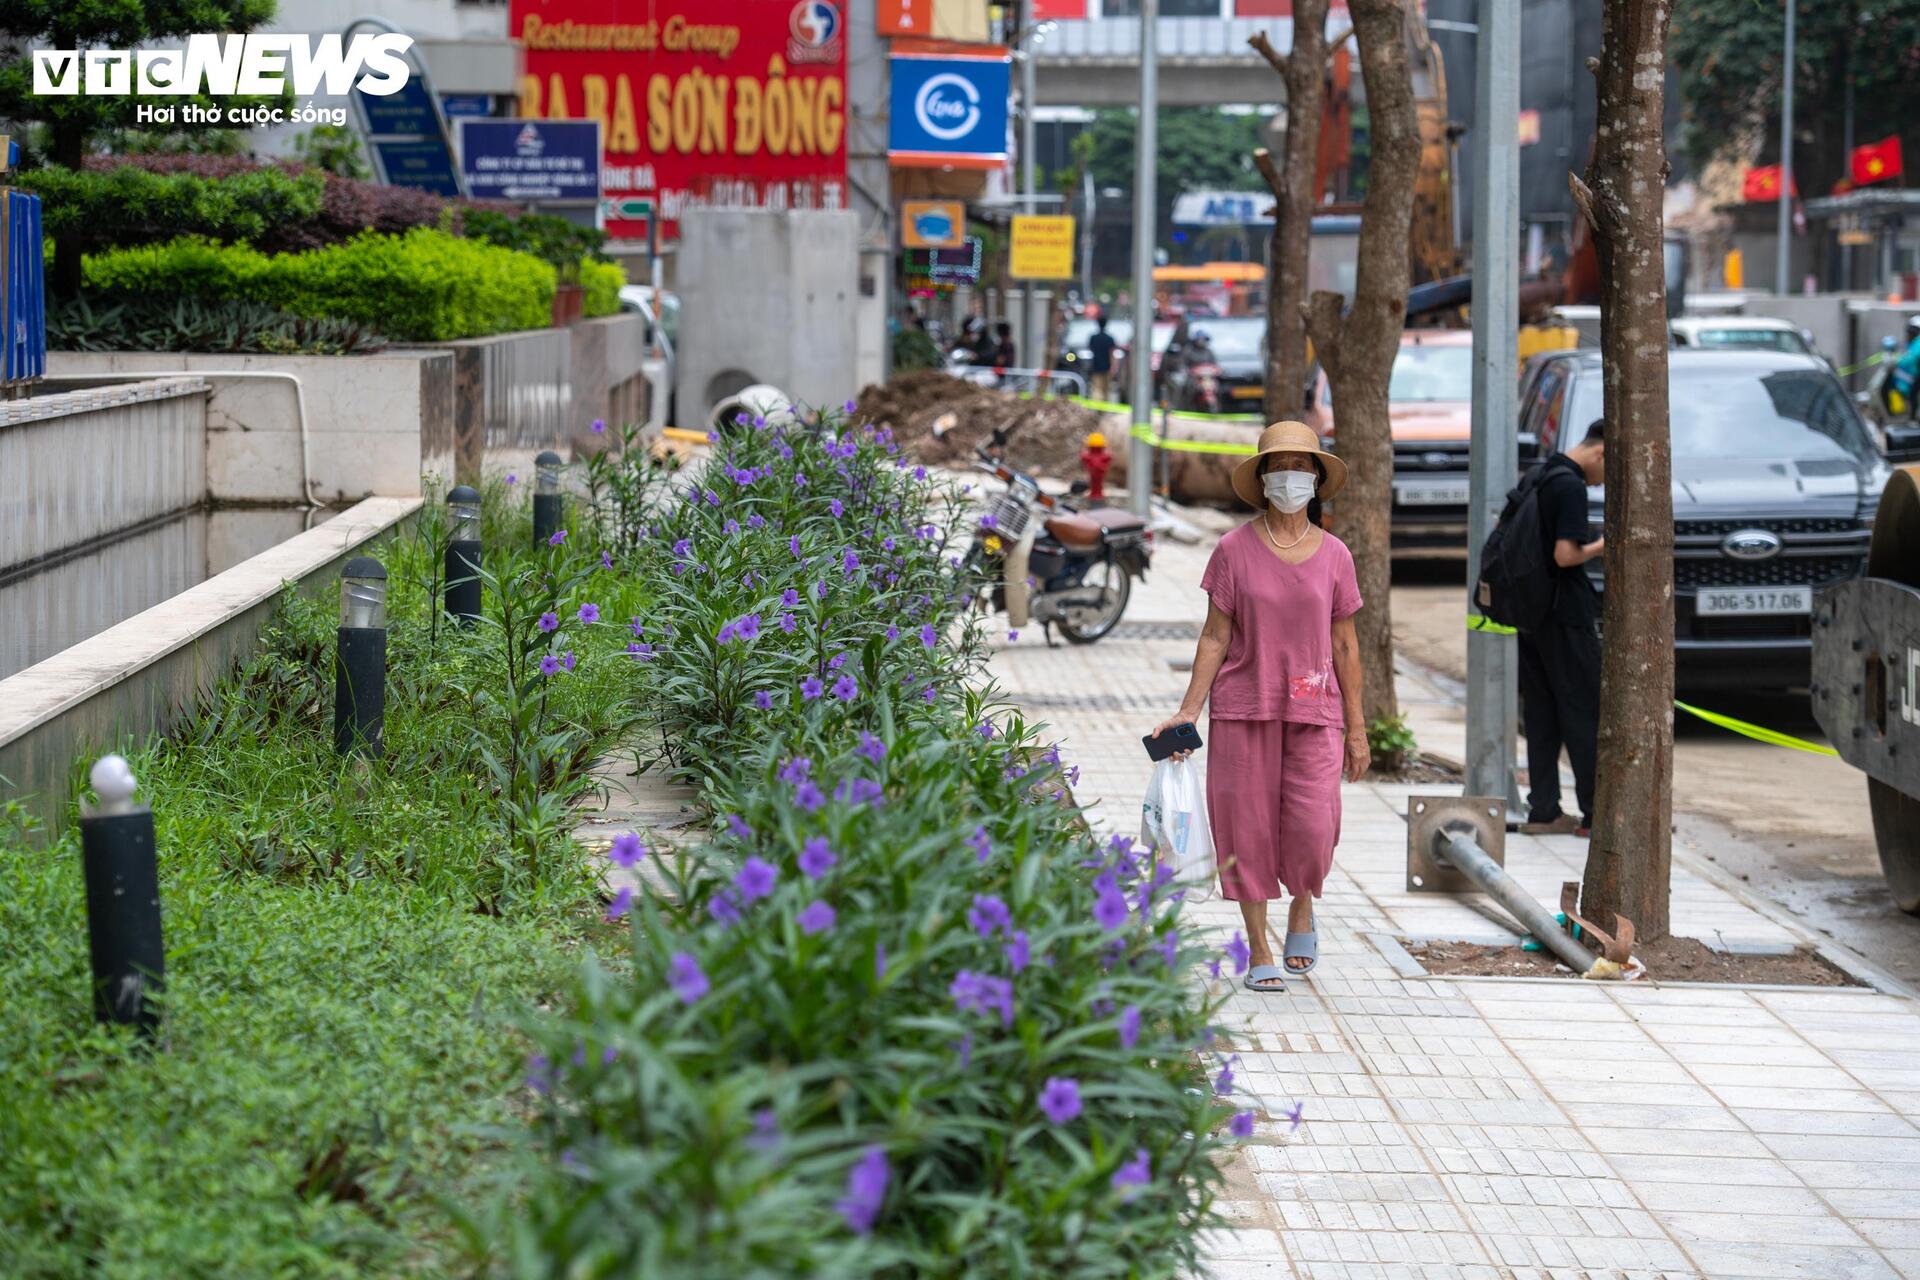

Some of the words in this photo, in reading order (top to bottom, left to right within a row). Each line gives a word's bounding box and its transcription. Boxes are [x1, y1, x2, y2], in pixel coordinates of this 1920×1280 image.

[522, 14, 660, 51] Restaurant
[662, 14, 740, 59] Group
[582, 73, 640, 154] BA
[647, 66, 730, 155] SƠN
[734, 53, 844, 156] ĐÔNG
[1707, 593, 1803, 610] 30G-517.06
